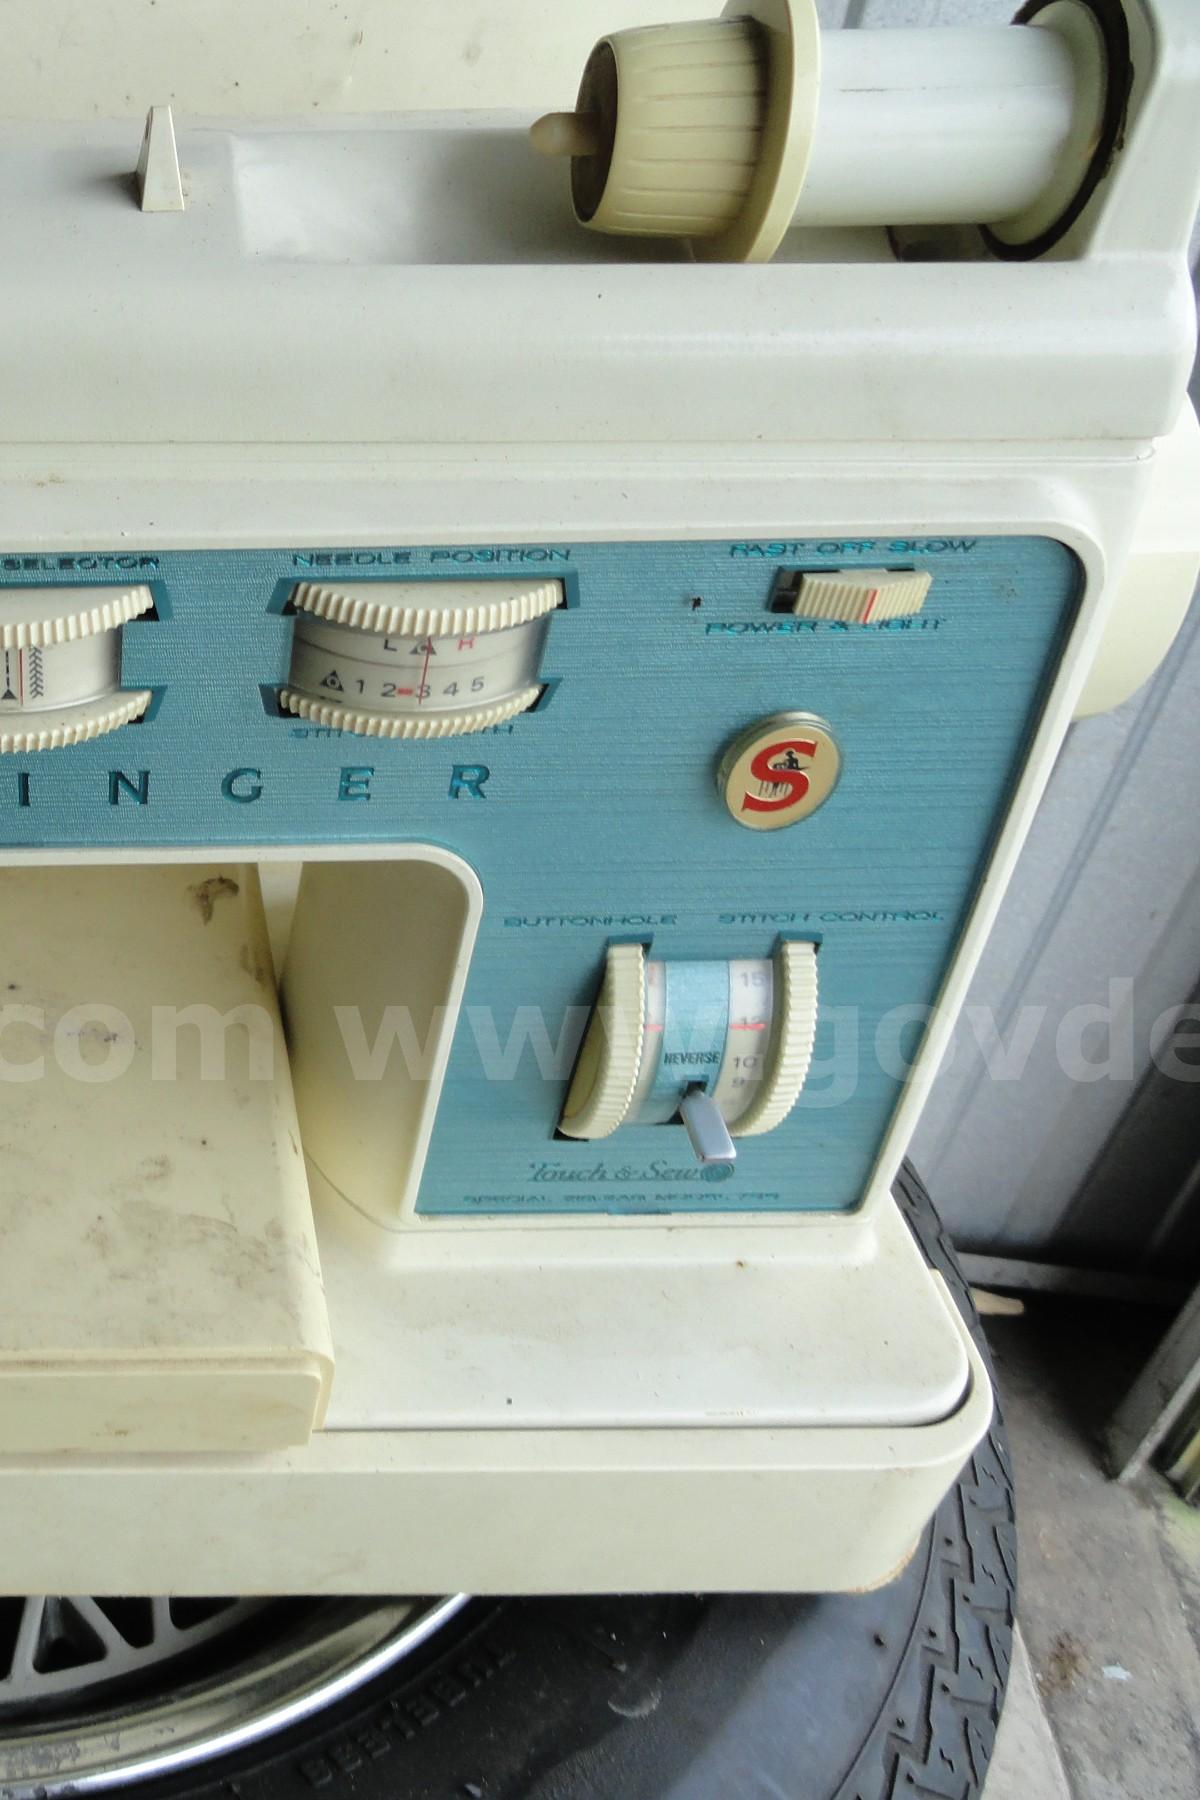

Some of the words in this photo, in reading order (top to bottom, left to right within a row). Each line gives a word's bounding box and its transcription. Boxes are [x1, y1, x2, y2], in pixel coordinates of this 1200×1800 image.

[729, 542, 804, 558] FAST
[816, 540, 876, 555] OFF
[888, 539, 978, 555] SLOW
[2, 557, 160, 572] SELECTOR
[293, 551, 412, 568] NEEDLE
[429, 549, 571, 564] POSITION
[705, 620, 818, 635] POWER
[383, 638, 398, 651] L
[457, 638, 477, 651] H
[354, 679, 365, 694] 1
[380, 681, 397, 697] 2
[416, 682, 431, 697] 3
[442, 681, 460, 696] 4
[471, 676, 485, 692] 5
[741, 738, 818, 812] S
[503, 913, 679, 928] BUTTONHOLE
[818, 910, 945, 924] CONTROL
[740, 971, 765, 987] 15
[663, 1051, 721, 1066] REVERSE
[529, 1161, 606, 1181] Touch
[641, 1161, 701, 1181] Sew
